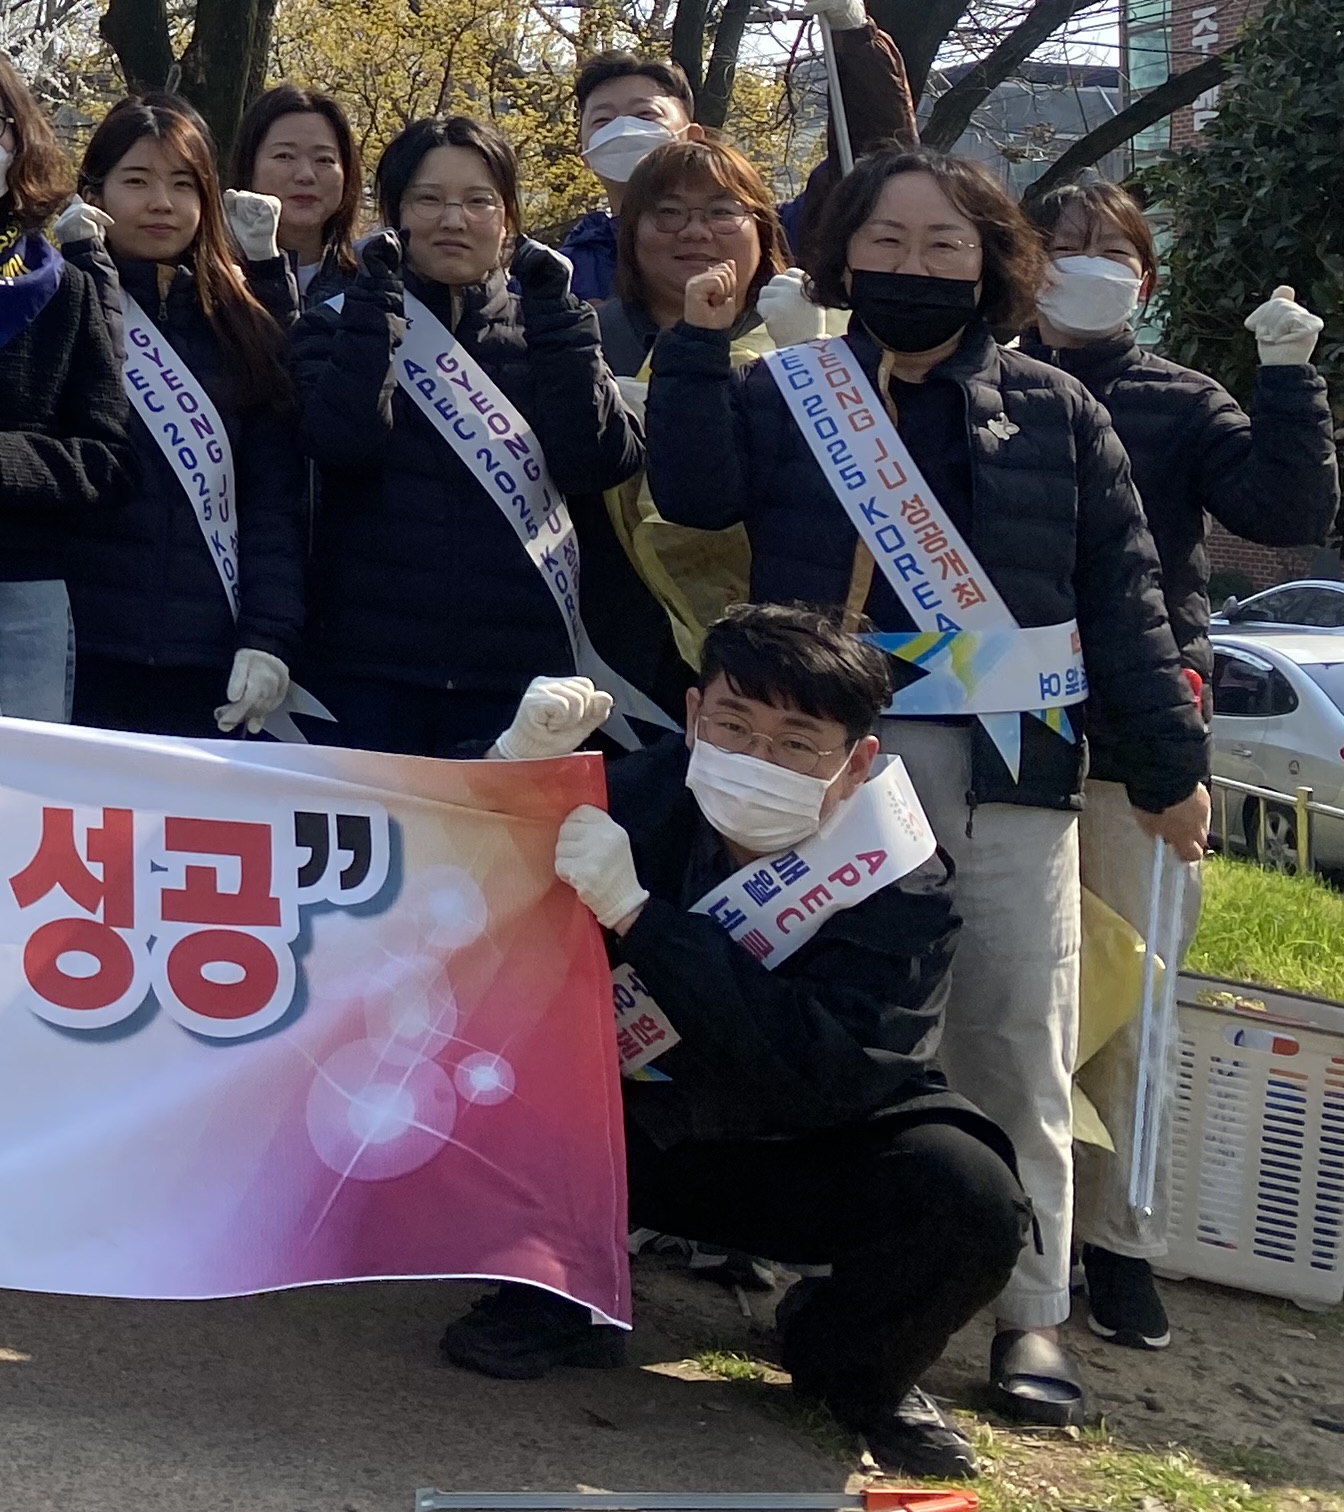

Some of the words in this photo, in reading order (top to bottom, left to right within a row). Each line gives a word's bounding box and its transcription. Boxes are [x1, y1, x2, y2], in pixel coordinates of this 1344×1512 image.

[126, 368, 165, 413] EC
[163, 422, 212, 521] 2025
[129, 328, 223, 464] GYEONG
[218, 474, 229, 523] JU
[403, 358, 477, 441] APEC
[476, 447, 540, 540] 2025
[436, 352, 541, 482] GYEONG
[542, 488, 562, 535] JU
[776, 348, 814, 390] EC
[802, 394, 866, 490] 2025
[859, 496, 963, 633] KOREA
[808, 340, 876, 432] YEONG
[873, 438, 908, 489] JU
[900, 493, 987, 609] 성공개최
[9, 806, 373, 1020] 성공”
[742, 850, 812, 908] 매월
[775, 848, 889, 935] APEC
